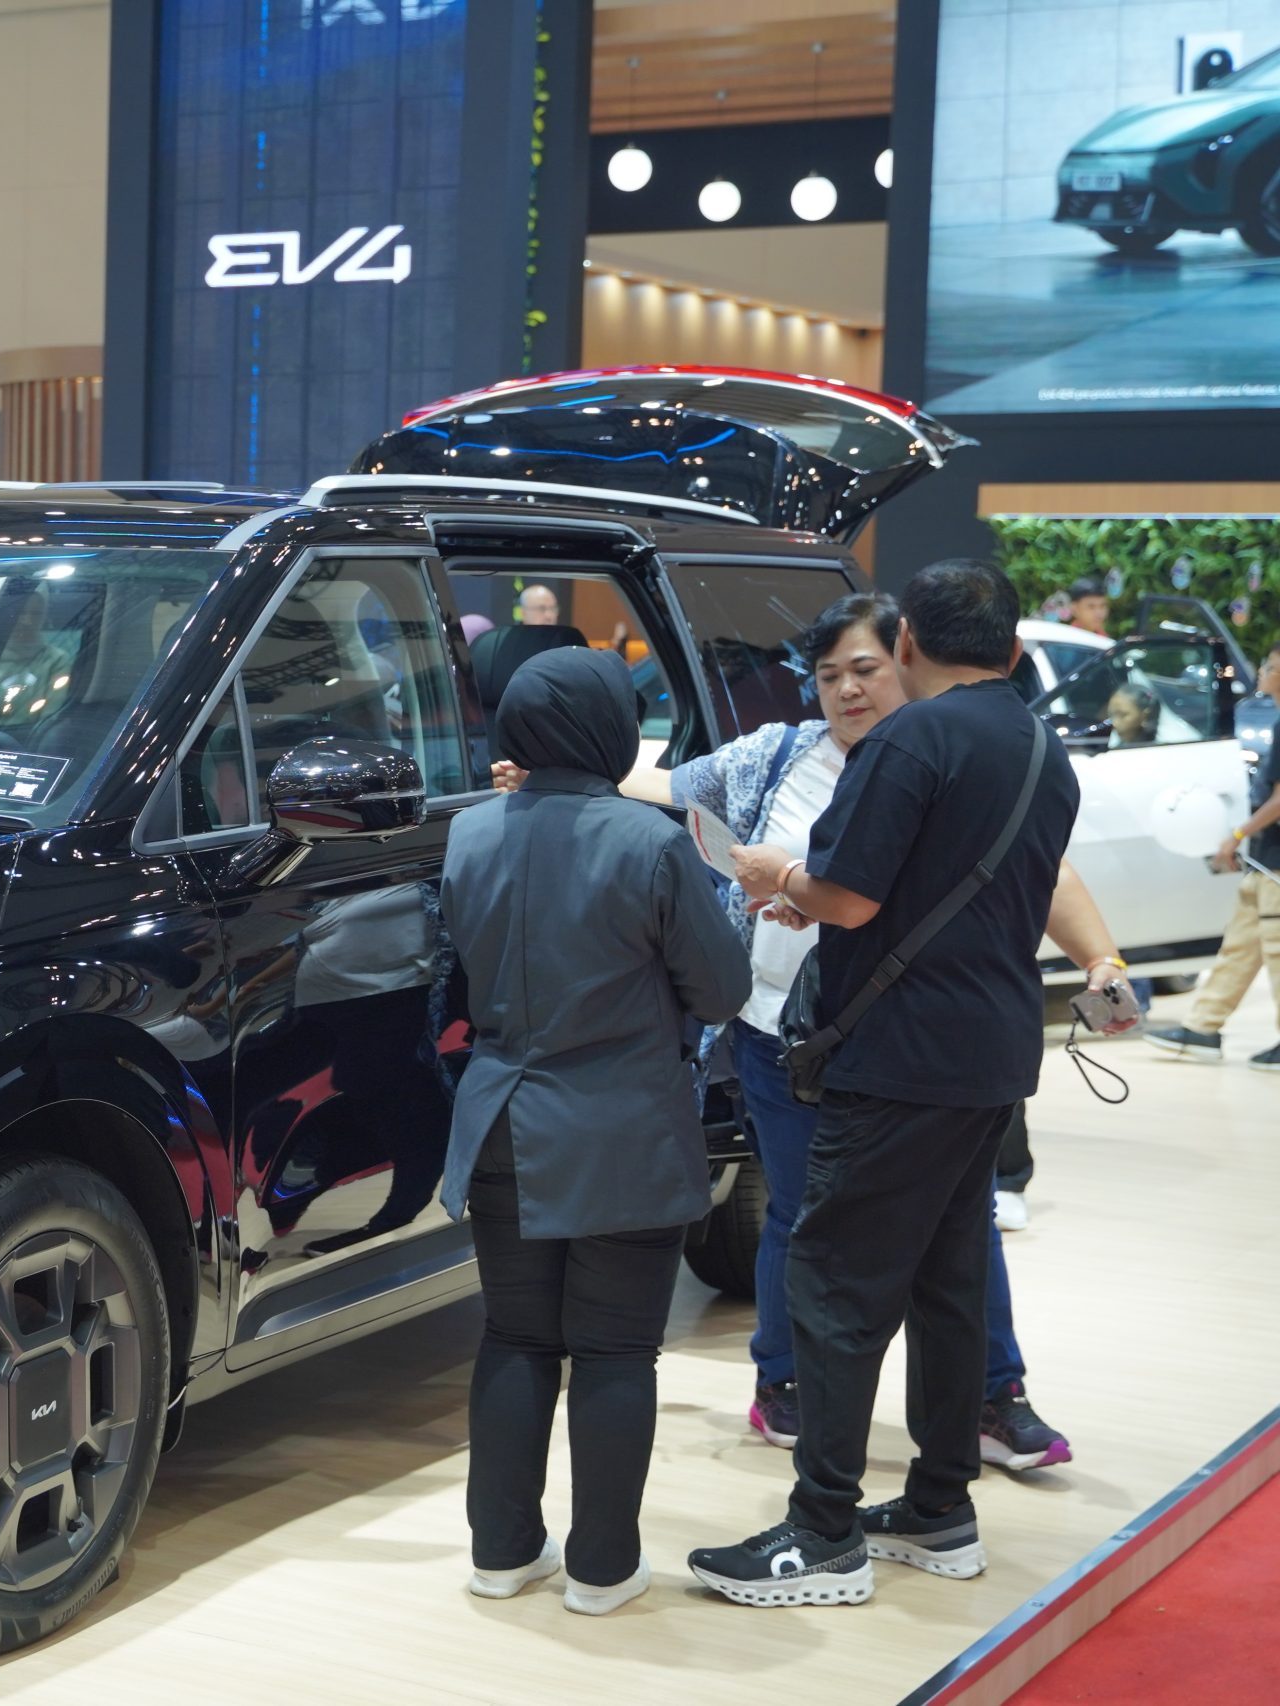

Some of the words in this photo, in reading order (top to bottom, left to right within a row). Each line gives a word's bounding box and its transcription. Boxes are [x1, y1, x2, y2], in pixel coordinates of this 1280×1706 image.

[204, 225, 412, 288] EV4
[31, 1400, 56, 1420] KIA
[801, 1548, 861, 1577] RUNNING
